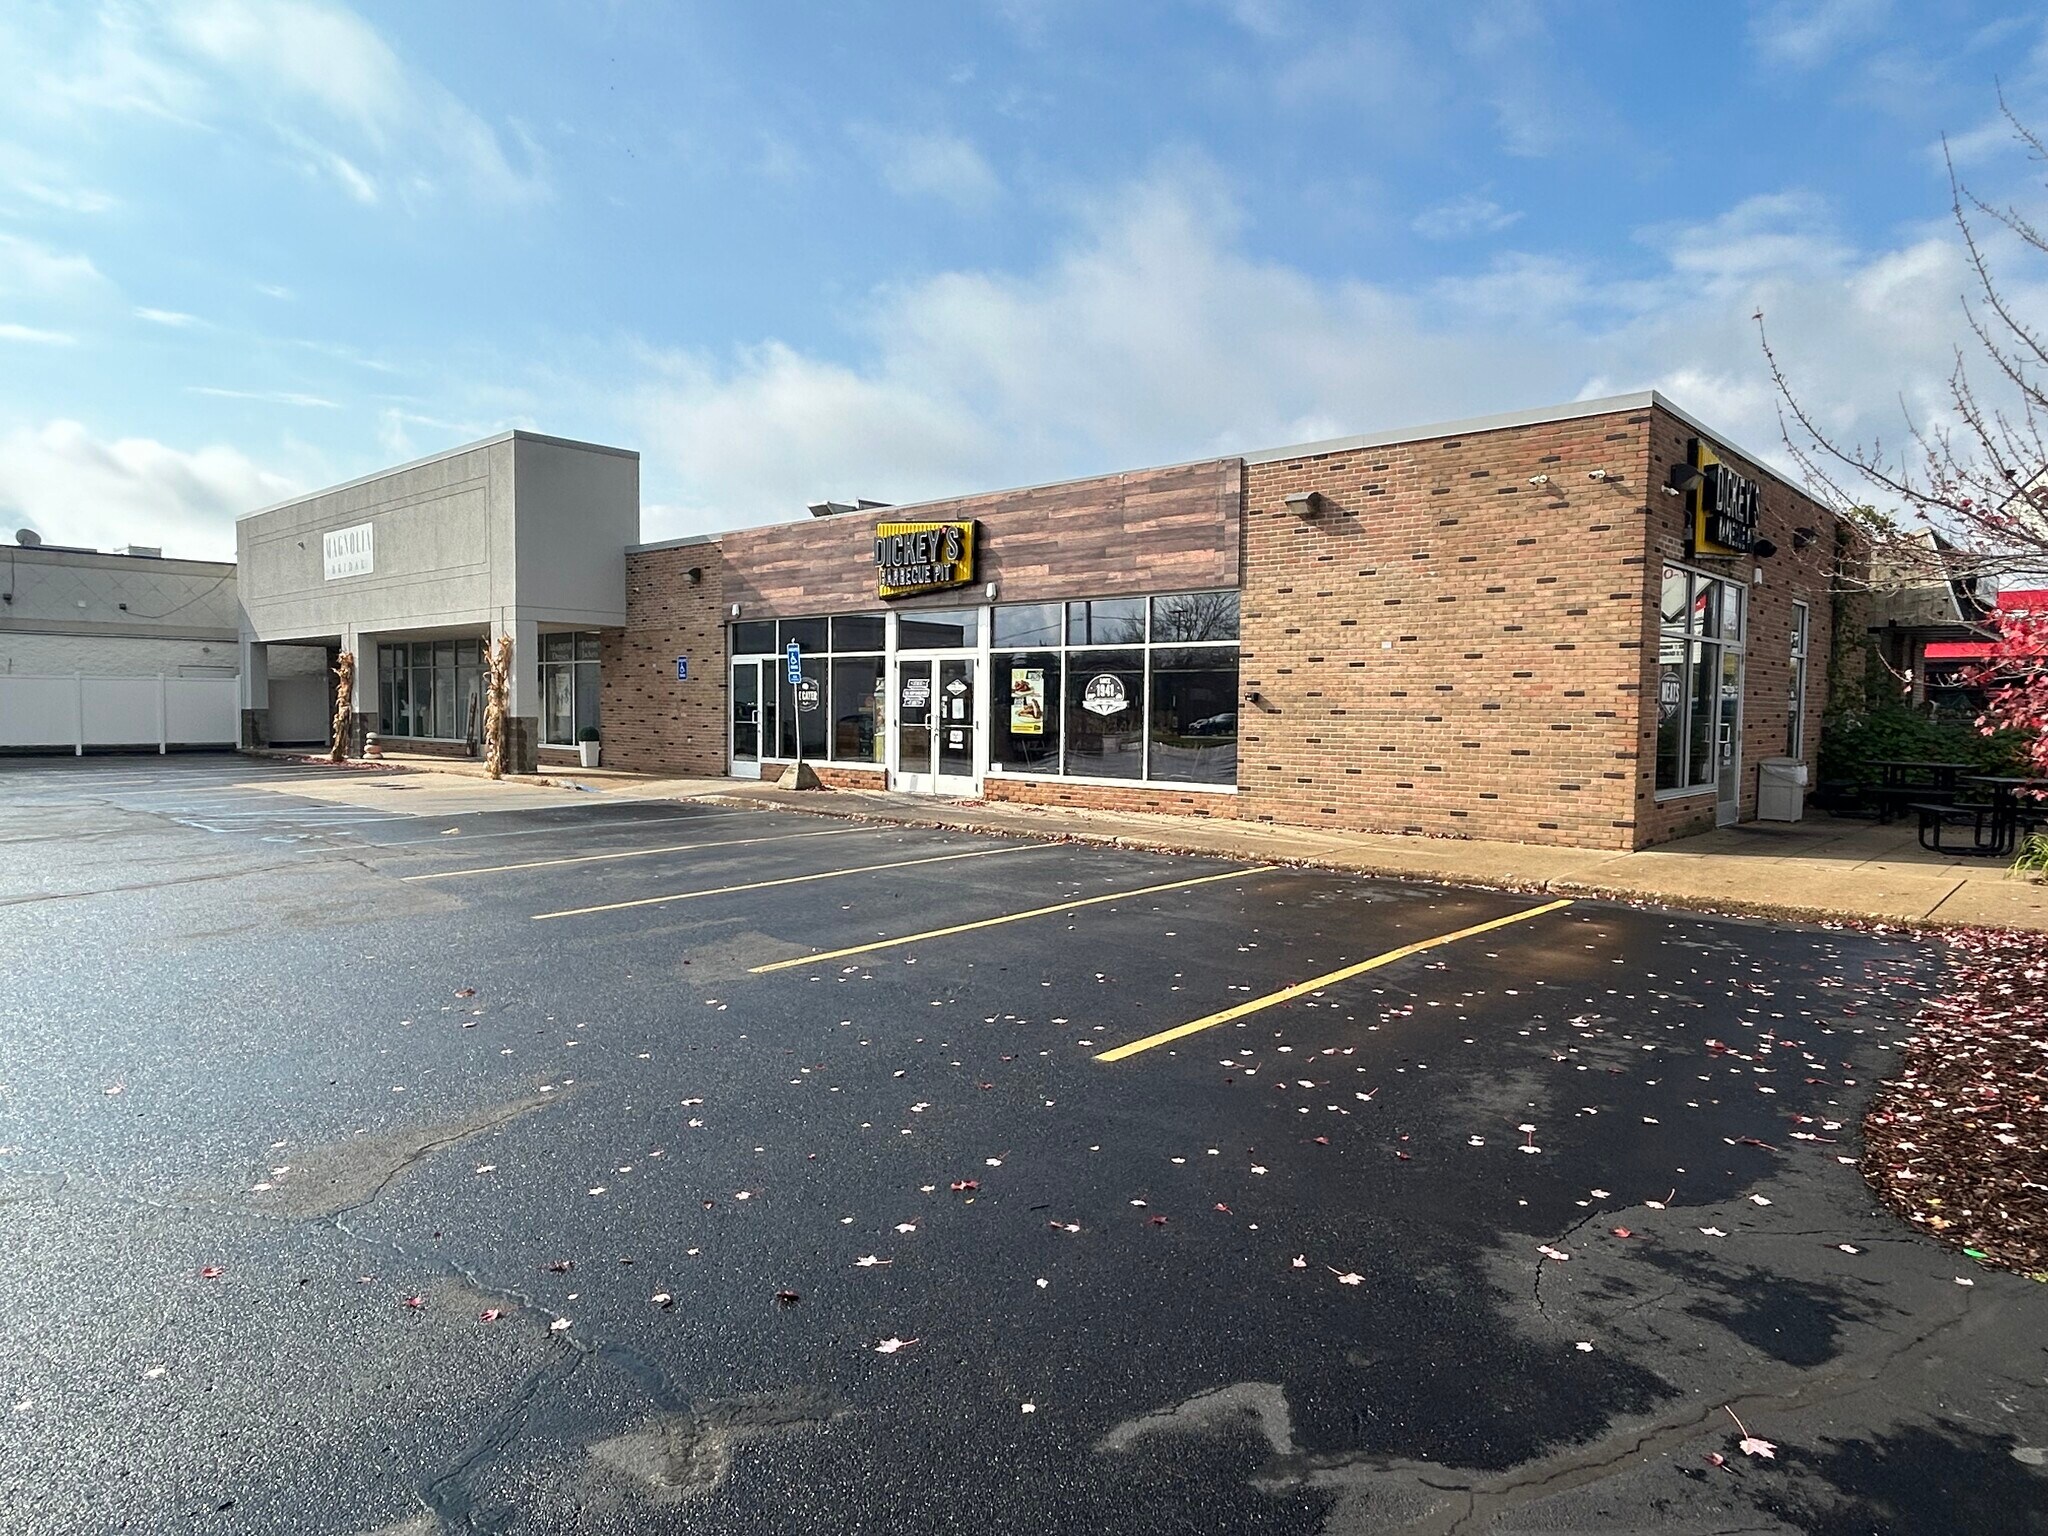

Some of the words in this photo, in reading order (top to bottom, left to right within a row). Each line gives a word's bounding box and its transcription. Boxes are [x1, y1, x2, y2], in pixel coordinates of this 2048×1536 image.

[1715, 464, 1761, 528] DICKEY'S
[325, 529, 371, 559] MAGNOLIA
[874, 526, 959, 567] DICKEY'S
[331, 560, 365, 575] BRIDAL
[879, 564, 931, 587] BARBECUE
[933, 563, 951, 582] PIT
[1096, 684, 1115, 697] 1941
[1661, 682, 1680, 703] MEATS
